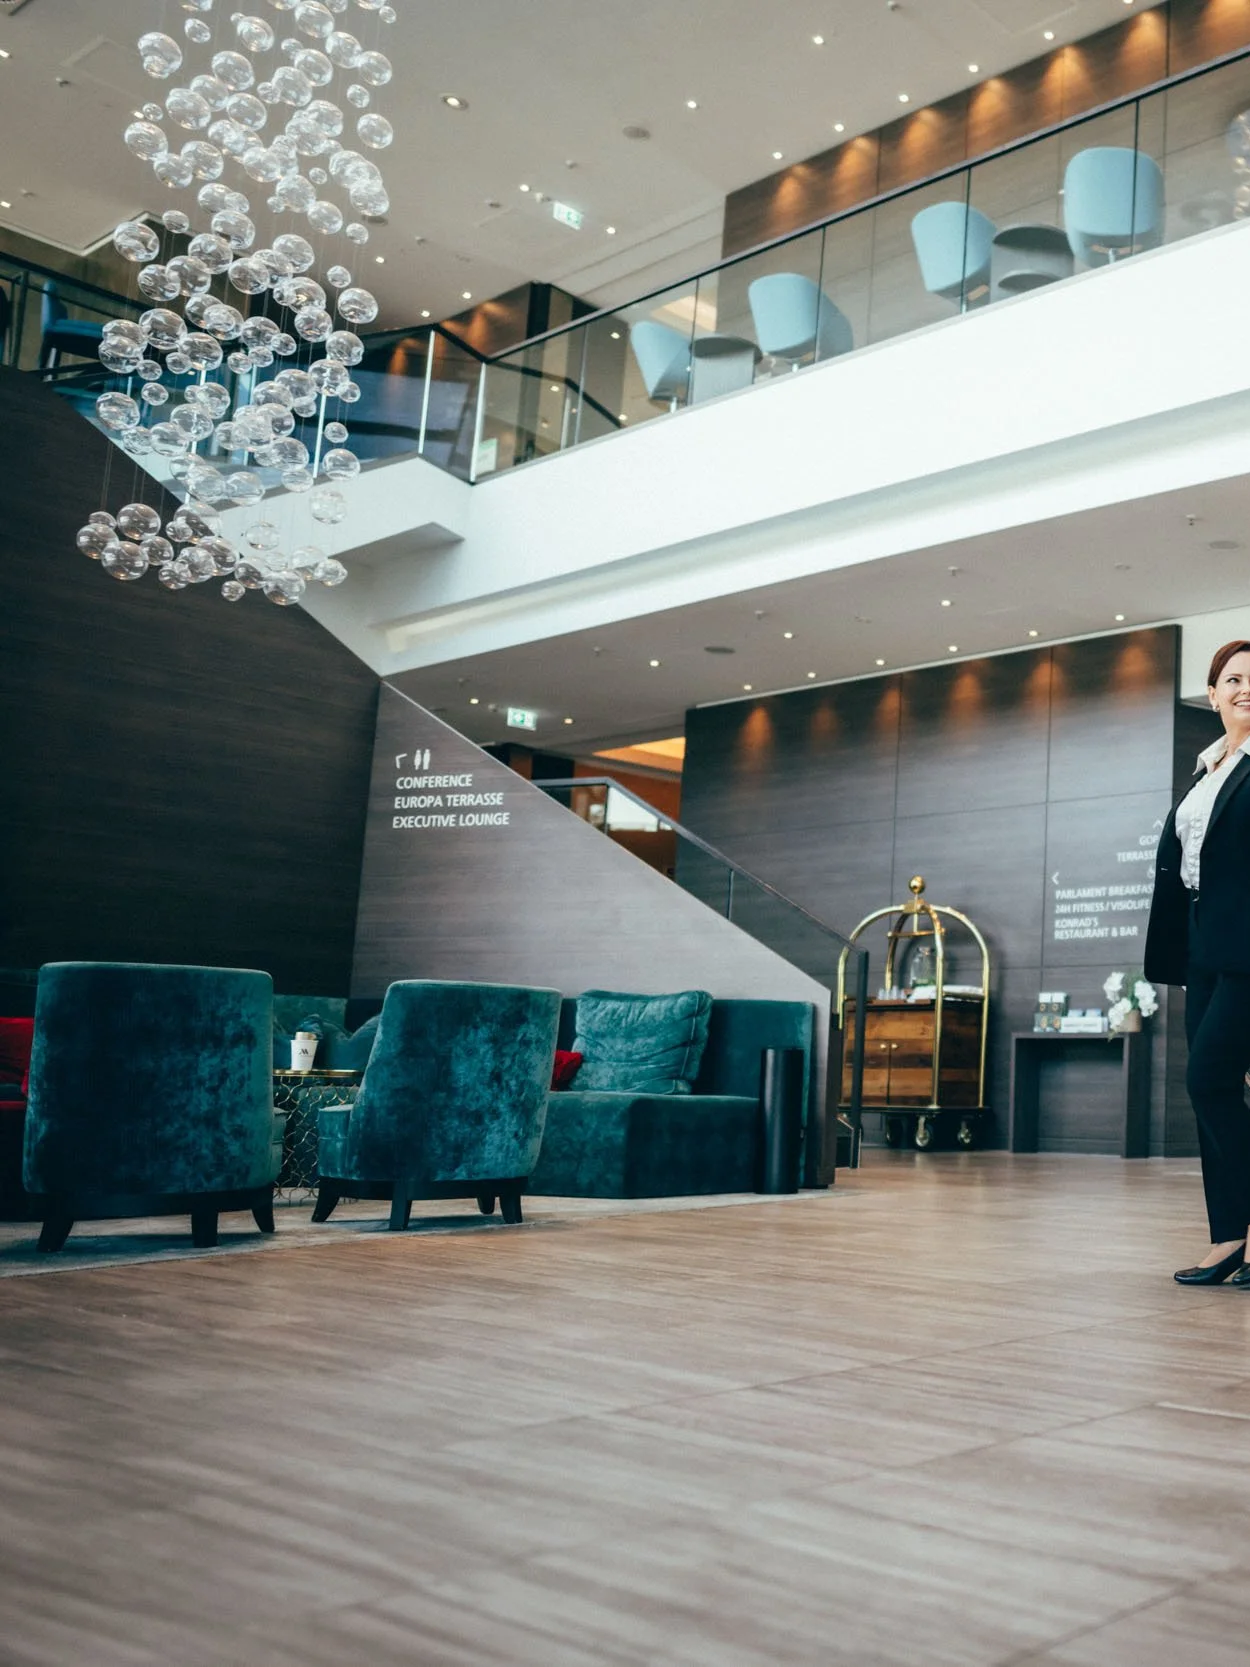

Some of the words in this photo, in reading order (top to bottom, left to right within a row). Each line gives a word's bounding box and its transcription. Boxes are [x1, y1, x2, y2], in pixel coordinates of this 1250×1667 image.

[396, 774, 473, 789] CONFERENCE
[394, 795, 443, 809] EUROPA
[447, 793, 504, 806] TERRASSE
[392, 814, 456, 828] EXECUTIVE
[459, 812, 510, 825] LOUNGE
[1056, 888, 1106, 899] PARLAMENT
[1108, 884, 1154, 896] BREAKFAS
[1072, 902, 1104, 913] FITNESS
[1111, 899, 1150, 911] VISIOLIFE
[1054, 917, 1099, 929] KONRAD'S
[1053, 928, 1109, 940] RESTAURANT
[1120, 926, 1138, 936] BAR
